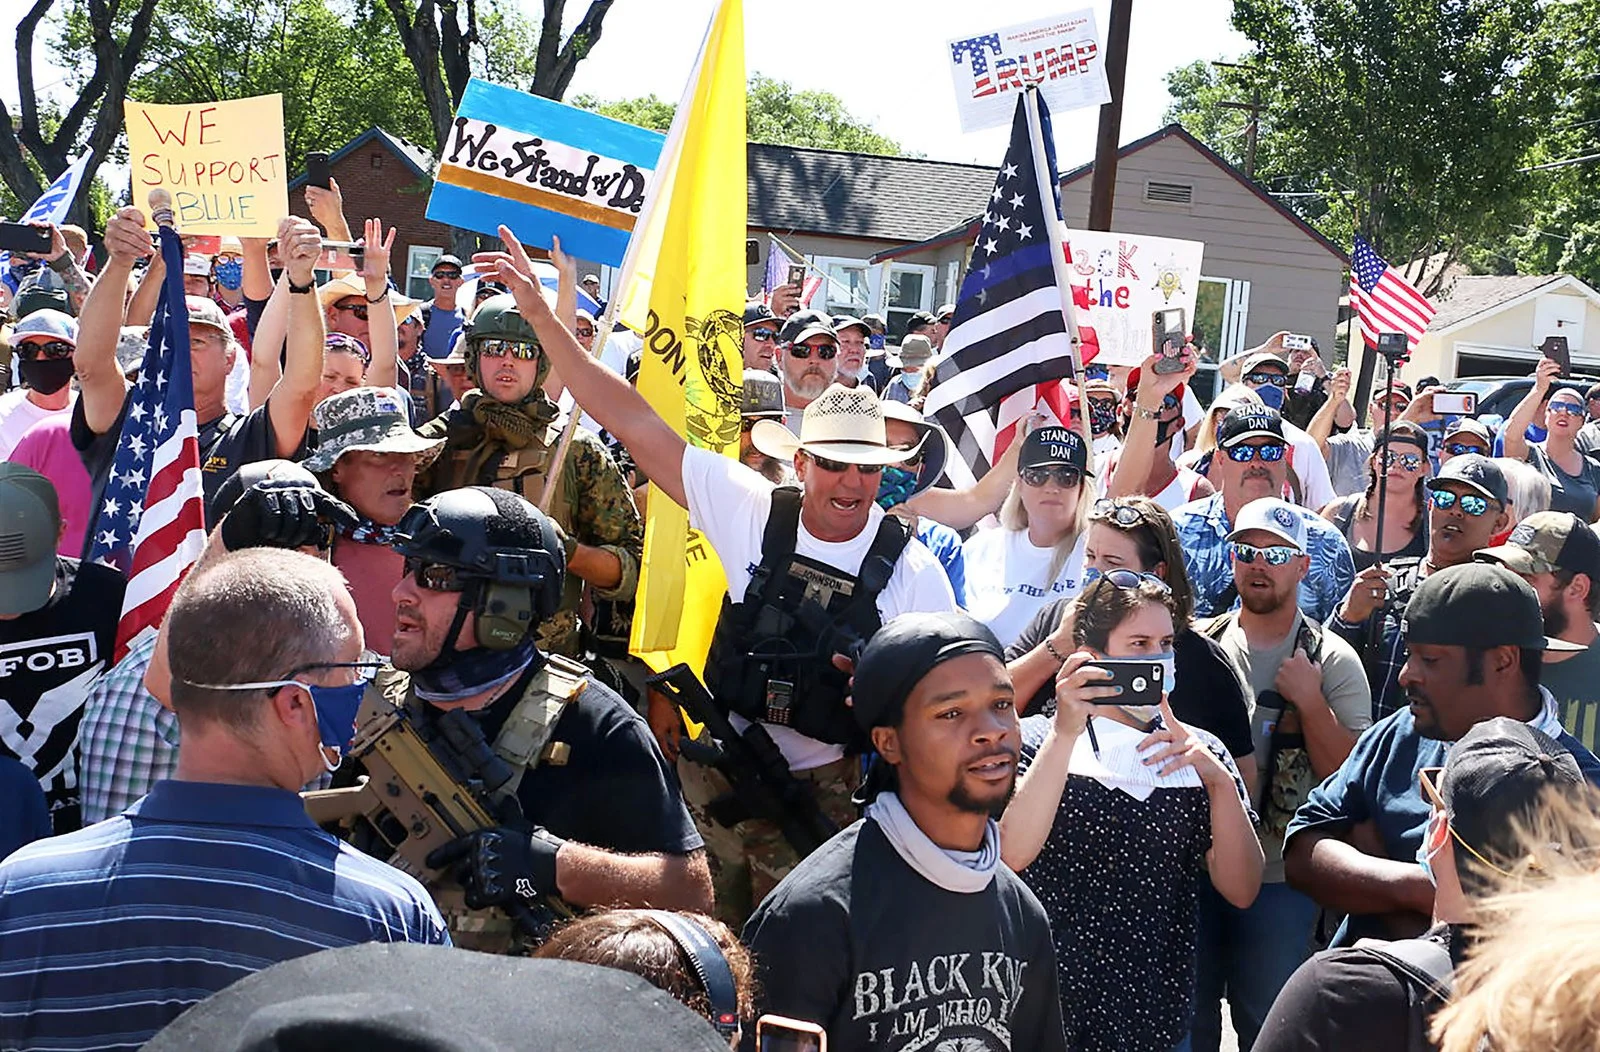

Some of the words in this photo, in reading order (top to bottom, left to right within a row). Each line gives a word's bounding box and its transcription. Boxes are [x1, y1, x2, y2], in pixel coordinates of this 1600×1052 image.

[950, 32, 1098, 98] TRUMP
[142, 107, 221, 147] WE
[141, 153, 280, 187] SUPPORT
[448, 116, 500, 172] We
[500, 137, 600, 198] Stand
[175, 191, 257, 223] BLUE
[1084, 278, 1131, 310] the
[1040, 429, 1070, 444] STAND
[1069, 434, 1079, 448] BY
[1247, 417, 1270, 430] DAN
[1050, 444, 1071, 460] DAN
[803, 569, 843, 591] JOHNSON
[852, 952, 973, 1021] BLACK
[868, 1021, 880, 1043] I
[886, 1007, 929, 1044] AM
[937, 996, 992, 1031] WHO
